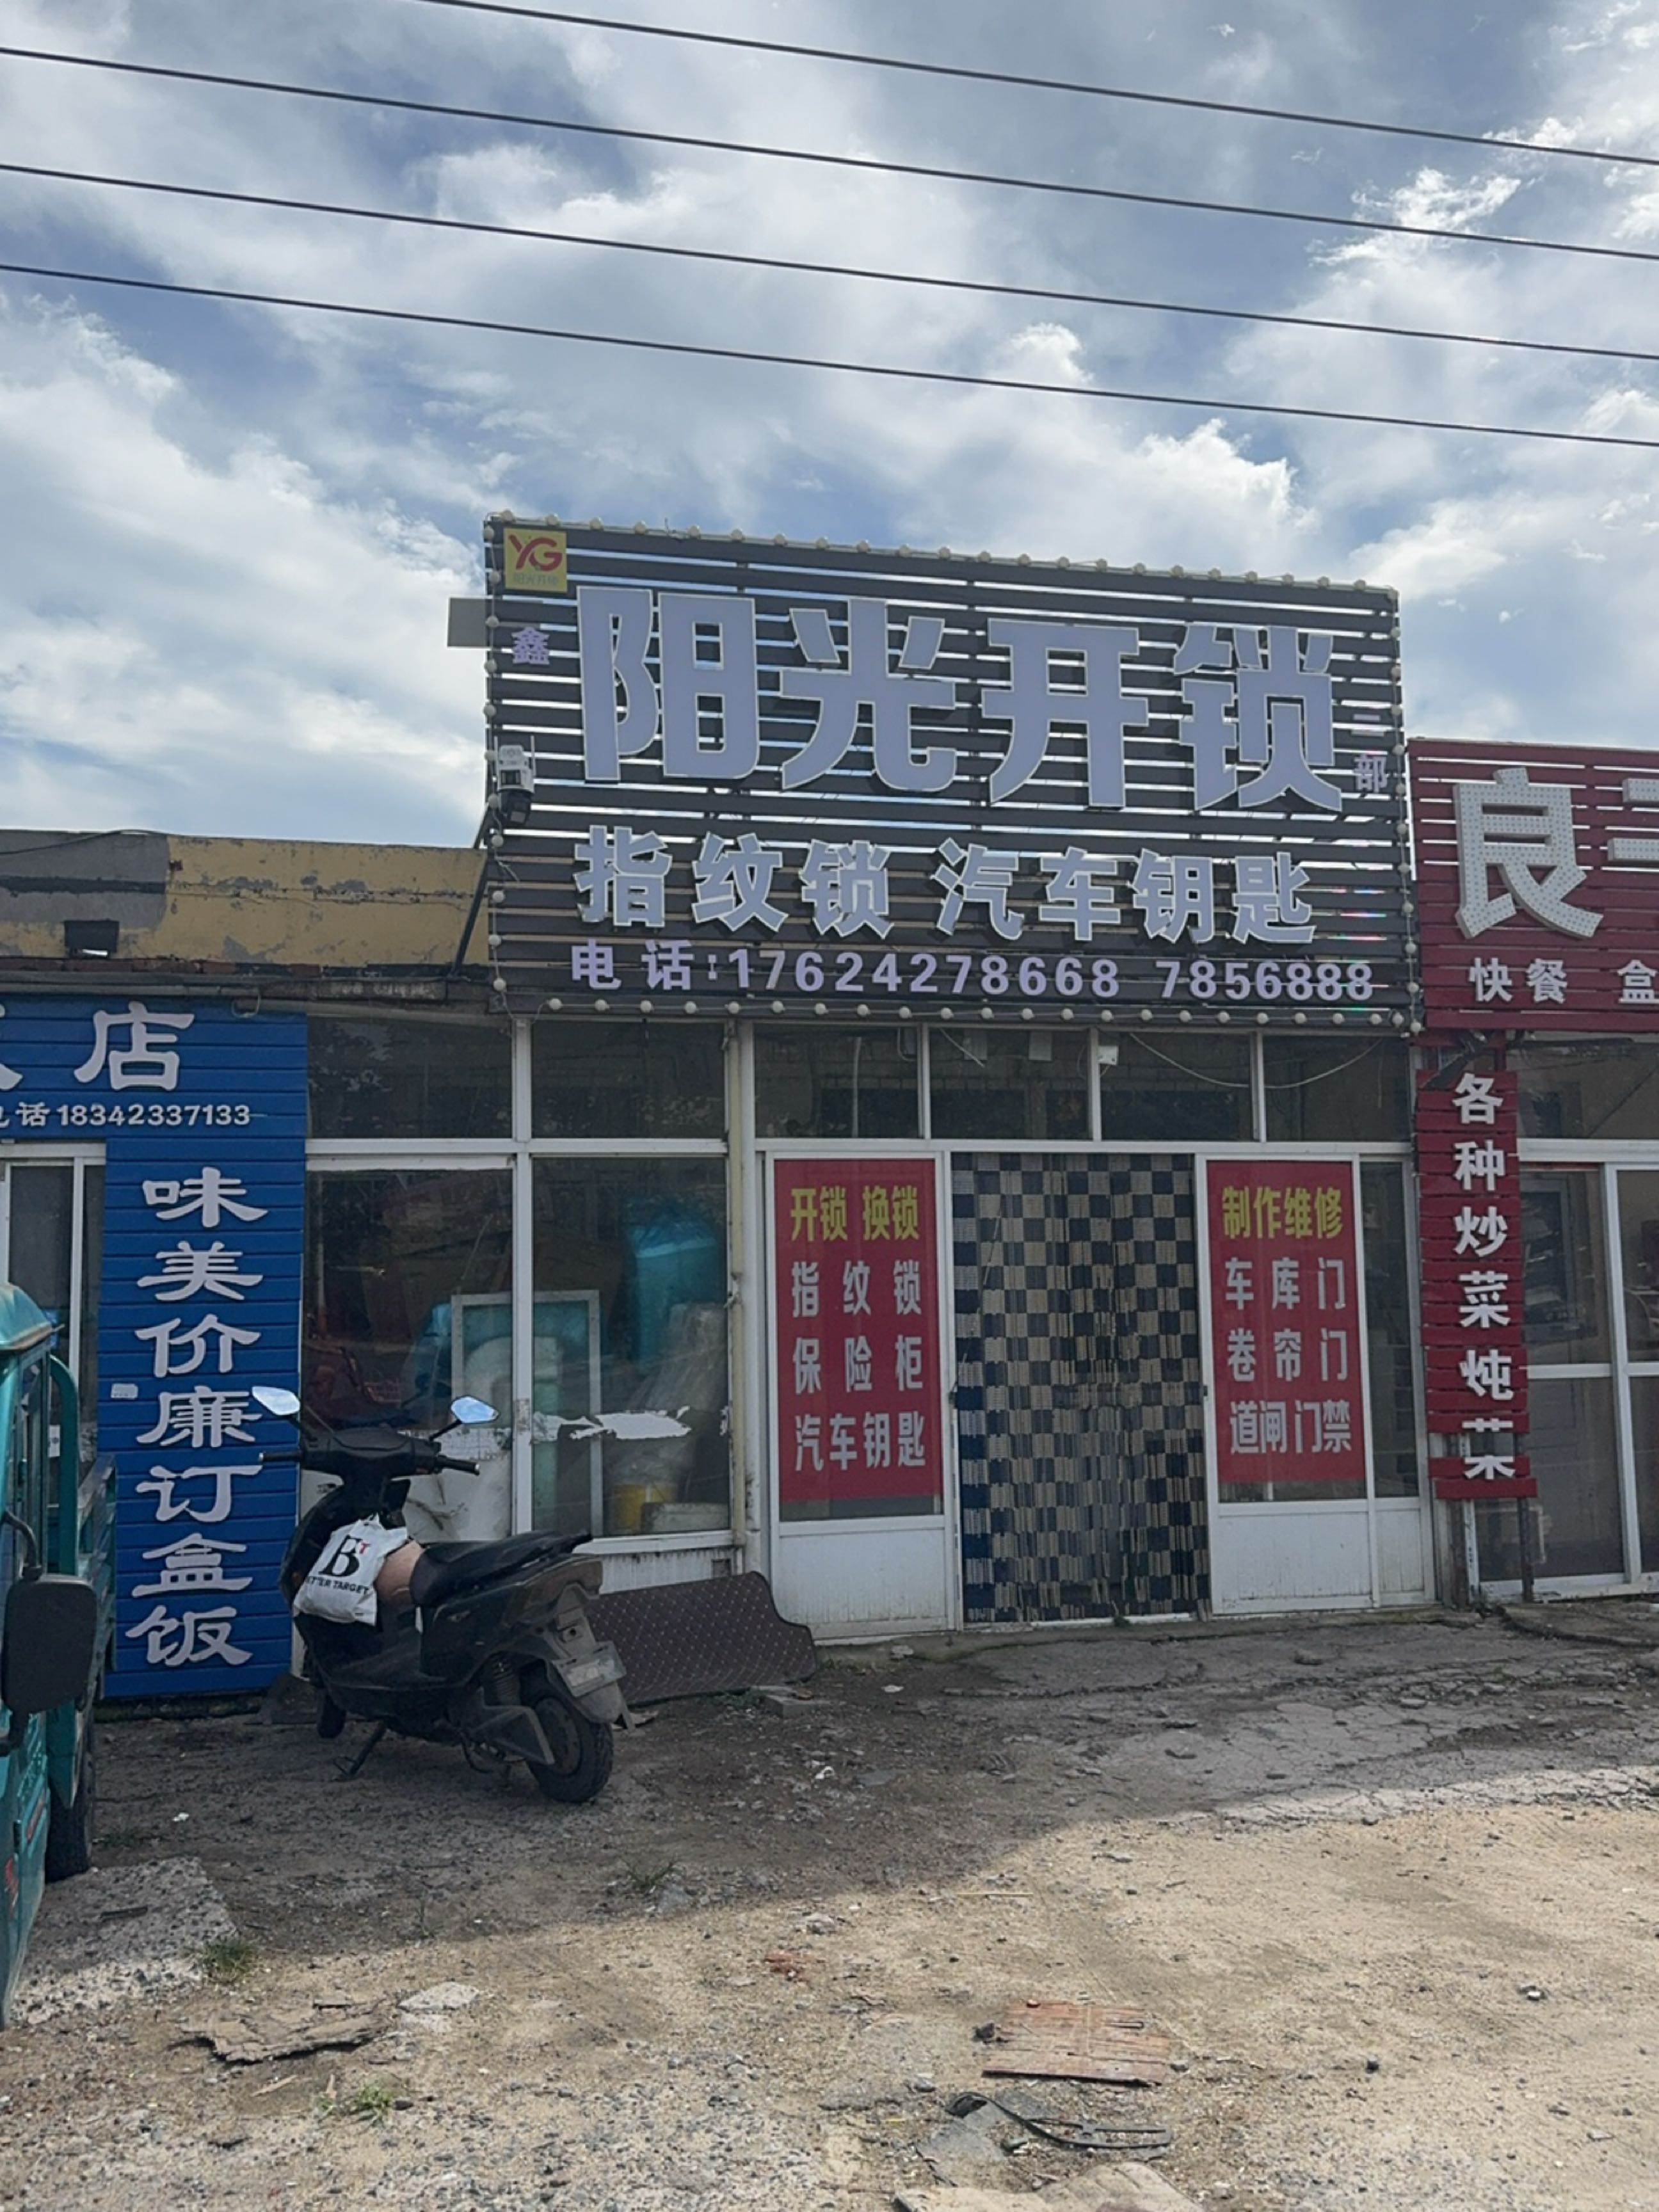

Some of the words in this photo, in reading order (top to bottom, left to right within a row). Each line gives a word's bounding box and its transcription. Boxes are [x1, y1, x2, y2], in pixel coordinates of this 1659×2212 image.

[508, 534, 563, 572] YG
[511, 626, 550, 665] 鑫
[577, 586, 1342, 811] 阳光开锁
[573, 824, 895, 939] 指纹锁
[930, 837, 1317, 944] 汽车钥匙
[1155, 959, 1374, 1001] 7856888
[1469, 958, 1567, 1004] 快餐
[0, 1001, 195, 1091] 店
[790, 1185, 848, 1242] 开锁
[862, 1185, 919, 1240] 换锁
[1221, 1185, 1343, 1240] 制作维修
[790, 1258, 922, 1318] 指纹锁
[1224, 1256, 1346, 1311] 车库门
[792, 1334, 923, 1394] 保险柜
[1226, 1327, 1349, 1382] 卷帘门
[125, 1166, 268, 1665] 味美价廉订盒饭
[794, 1411, 926, 1472] 汽车钥匙
[1230, 1399, 1352, 1454] 道闸门禁
